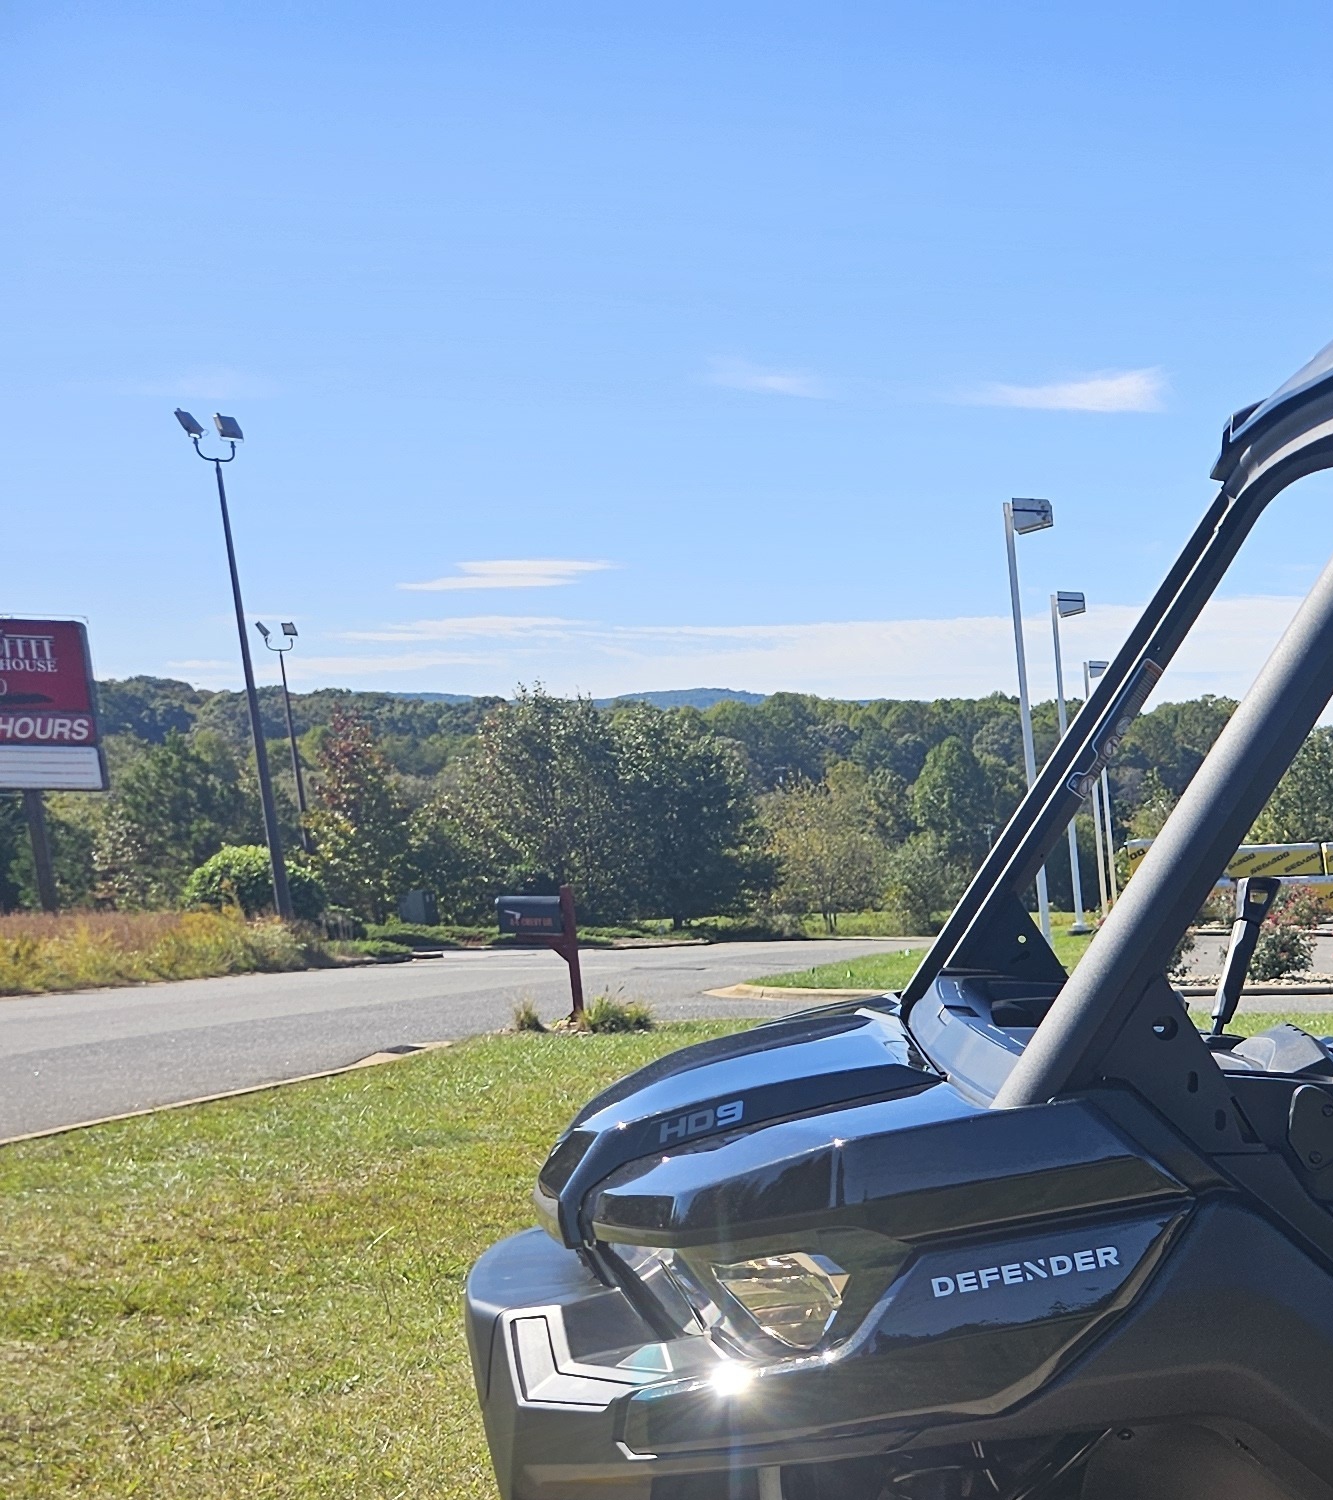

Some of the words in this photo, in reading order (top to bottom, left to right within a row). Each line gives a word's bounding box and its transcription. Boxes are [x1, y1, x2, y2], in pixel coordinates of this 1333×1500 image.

[0, 658, 58, 673] HOUSE
[0, 716, 89, 740] HOURS
[659, 1100, 744, 1143] HD9
[930, 1246, 1120, 1298] DEFENDER
